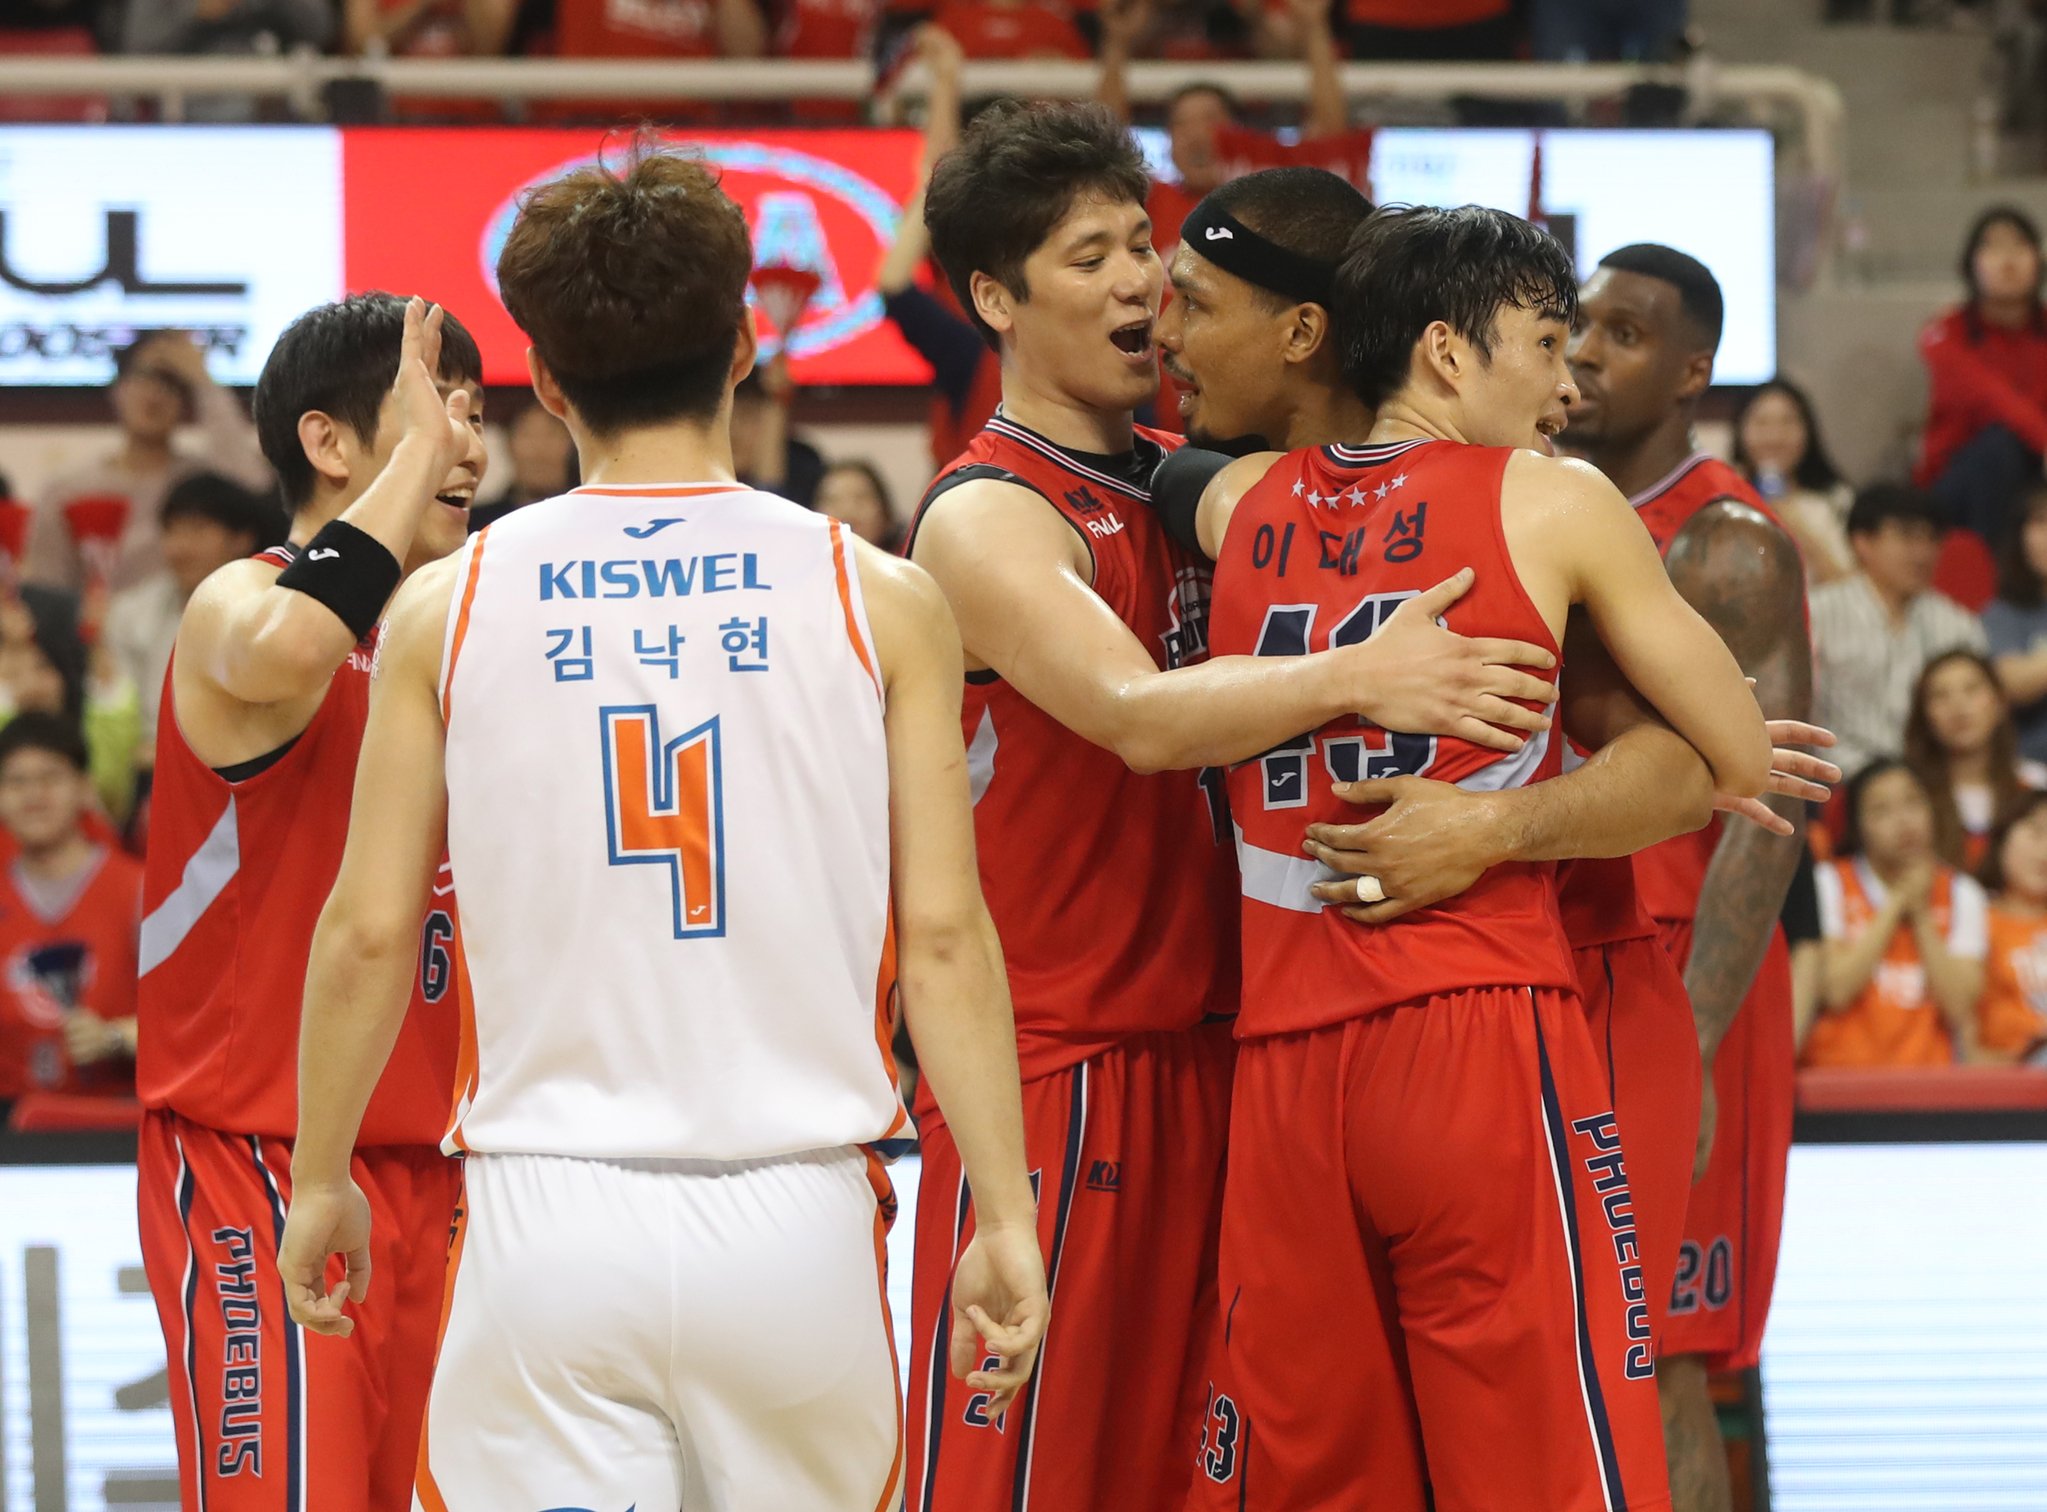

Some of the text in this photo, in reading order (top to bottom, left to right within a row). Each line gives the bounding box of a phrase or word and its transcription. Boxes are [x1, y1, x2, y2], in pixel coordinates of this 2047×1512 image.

[539, 552, 773, 602] KISWEL
[598, 703, 727, 940] 4
[420, 909, 455, 1004] 6
[1666, 1234, 1733, 1313] 20
[211, 1225, 263, 1479] PHOEBUS
[1196, 1380, 1240, 1484] 3
